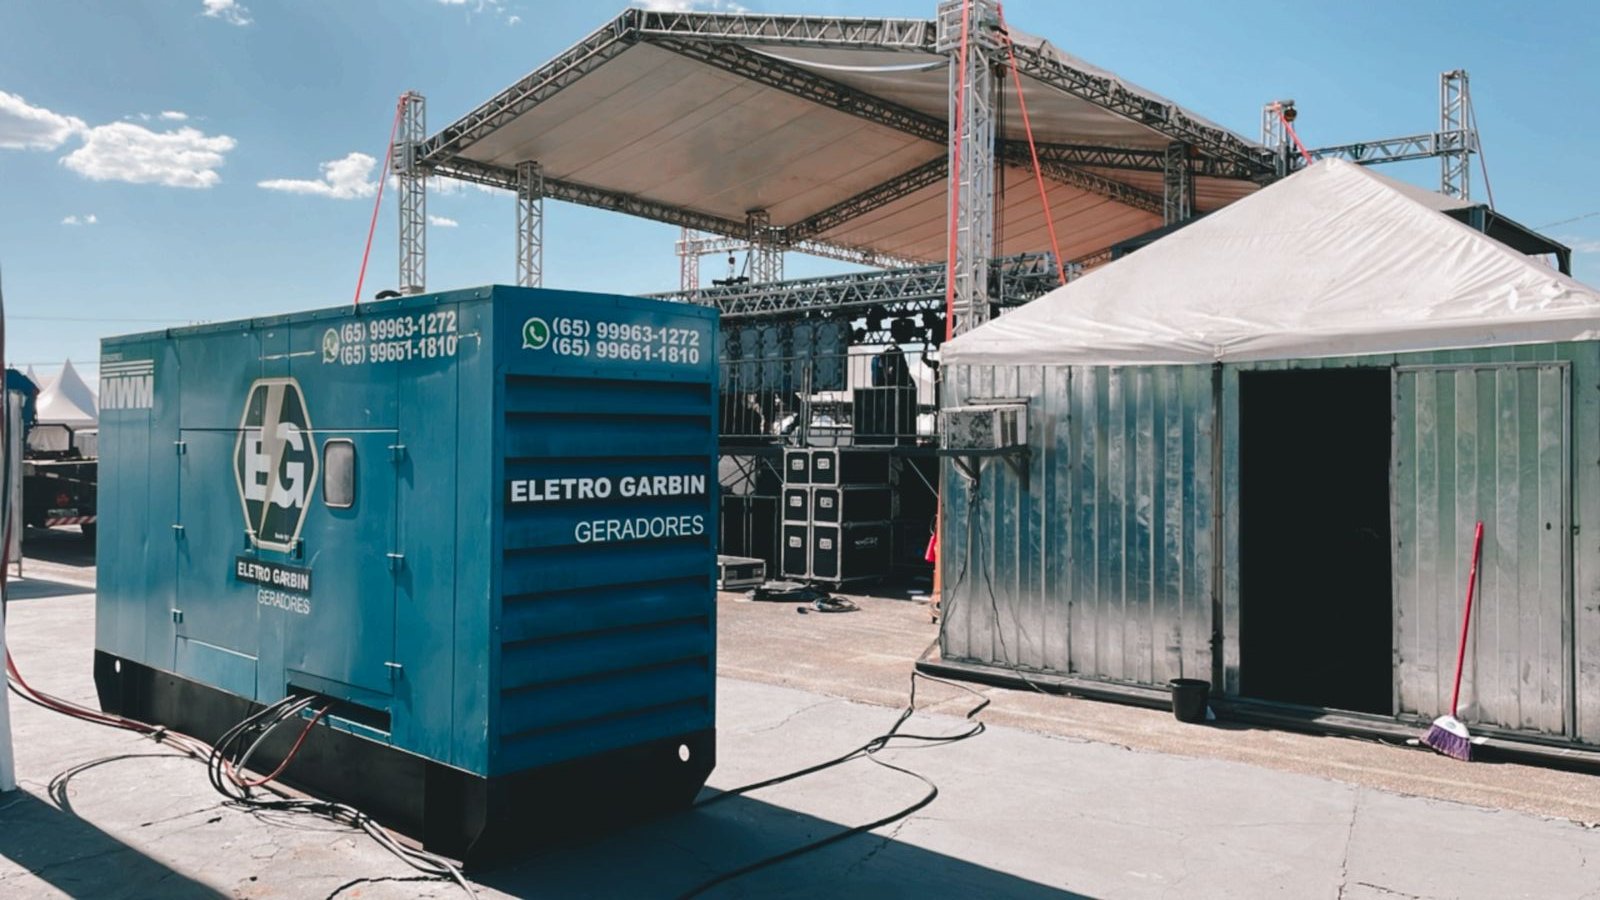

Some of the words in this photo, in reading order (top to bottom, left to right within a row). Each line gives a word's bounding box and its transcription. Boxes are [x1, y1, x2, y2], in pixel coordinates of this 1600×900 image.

[341, 322, 366, 344] (65)
[370, 311, 457, 340] 99963-1272
[552, 317, 591, 338] (65)
[596, 322, 700, 346] 99963-1272
[341, 345, 366, 365] (65)
[370, 335, 457, 363] 99661-1810
[552, 337, 591, 356] (65)
[596, 342, 700, 364] 99661-1810
[100, 375, 154, 409] MWM
[511, 477, 612, 502] ELETRO
[619, 475, 705, 497] GARBIN
[574, 514, 704, 543] GERADORES
[237, 561, 271, 582] ELETRO
[272, 568, 309, 590] GARBIN
